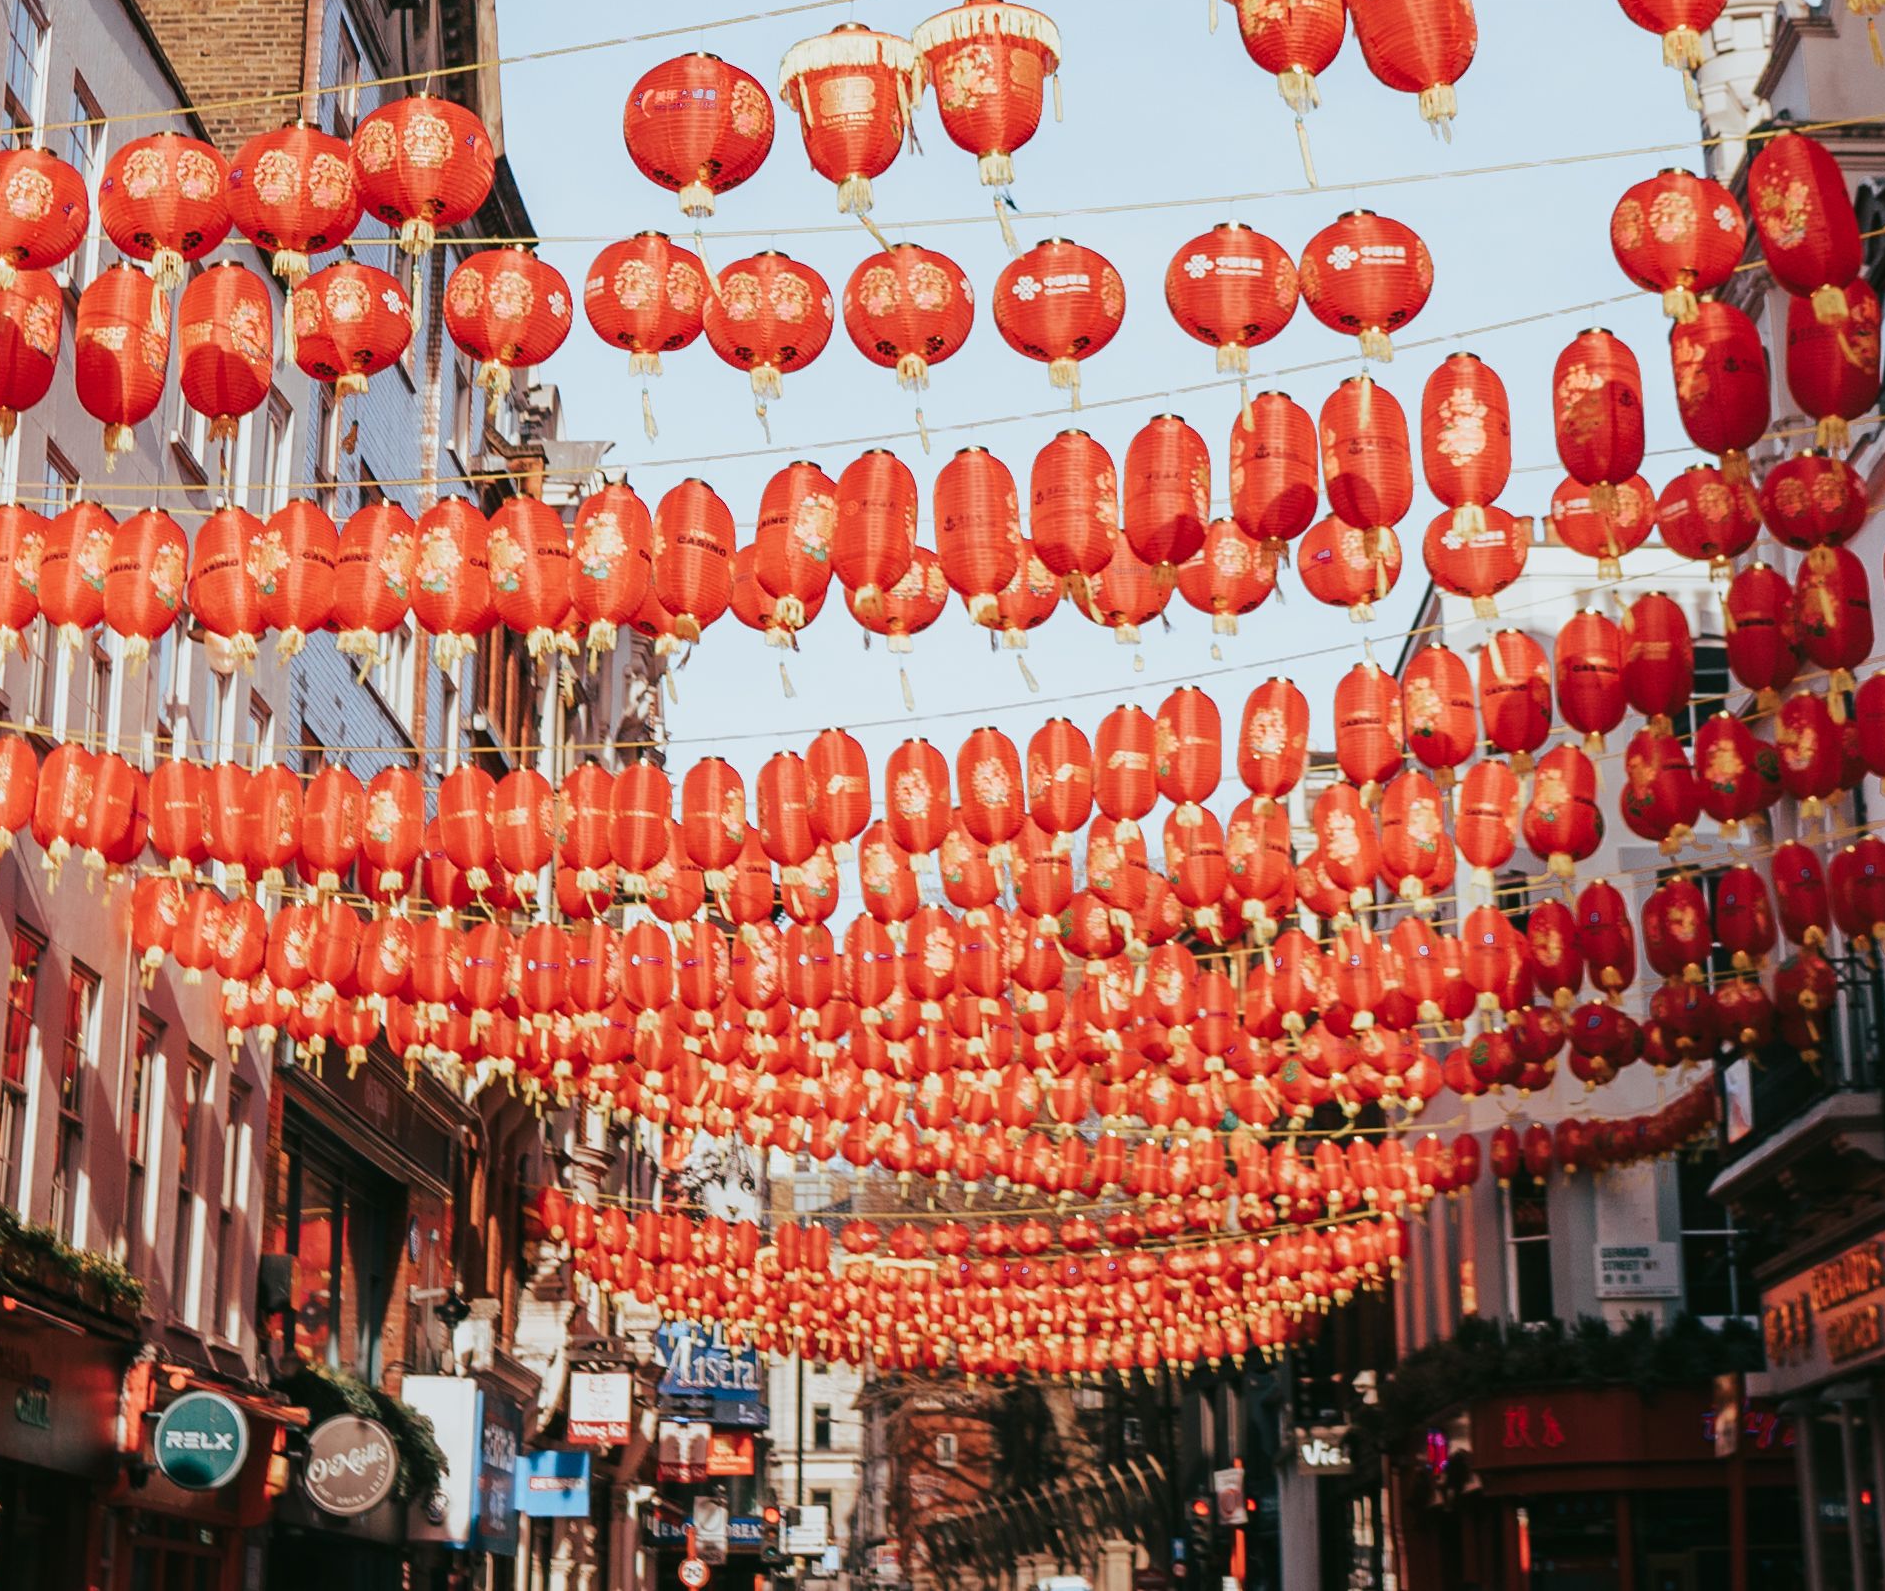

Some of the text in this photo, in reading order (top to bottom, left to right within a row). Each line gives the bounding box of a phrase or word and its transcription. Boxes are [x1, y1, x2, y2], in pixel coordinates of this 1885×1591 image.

[677, 535, 728, 559] CASINO
[1484, 683, 1528, 697] CASINO
[165, 1430, 234, 1451] RELX
